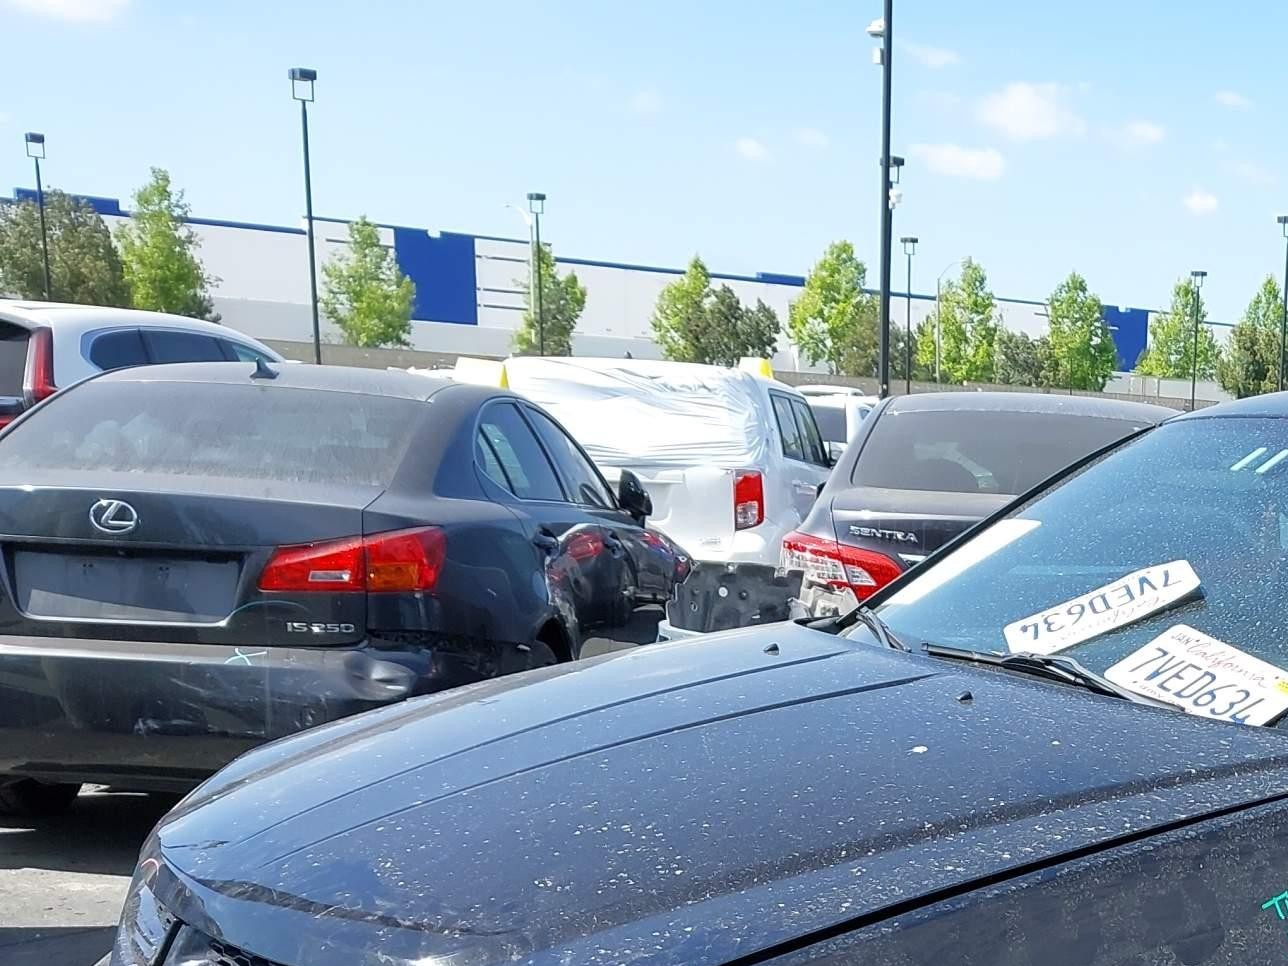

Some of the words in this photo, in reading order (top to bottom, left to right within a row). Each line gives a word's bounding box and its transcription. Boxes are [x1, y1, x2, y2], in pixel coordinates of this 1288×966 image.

[849, 525, 919, 544] SENTRA
[1020, 569, 1183, 641] 7VED634
[285, 622, 308, 633] IS
[311, 623, 355, 634] 250
[1128, 647, 1266, 725] 7VED634
